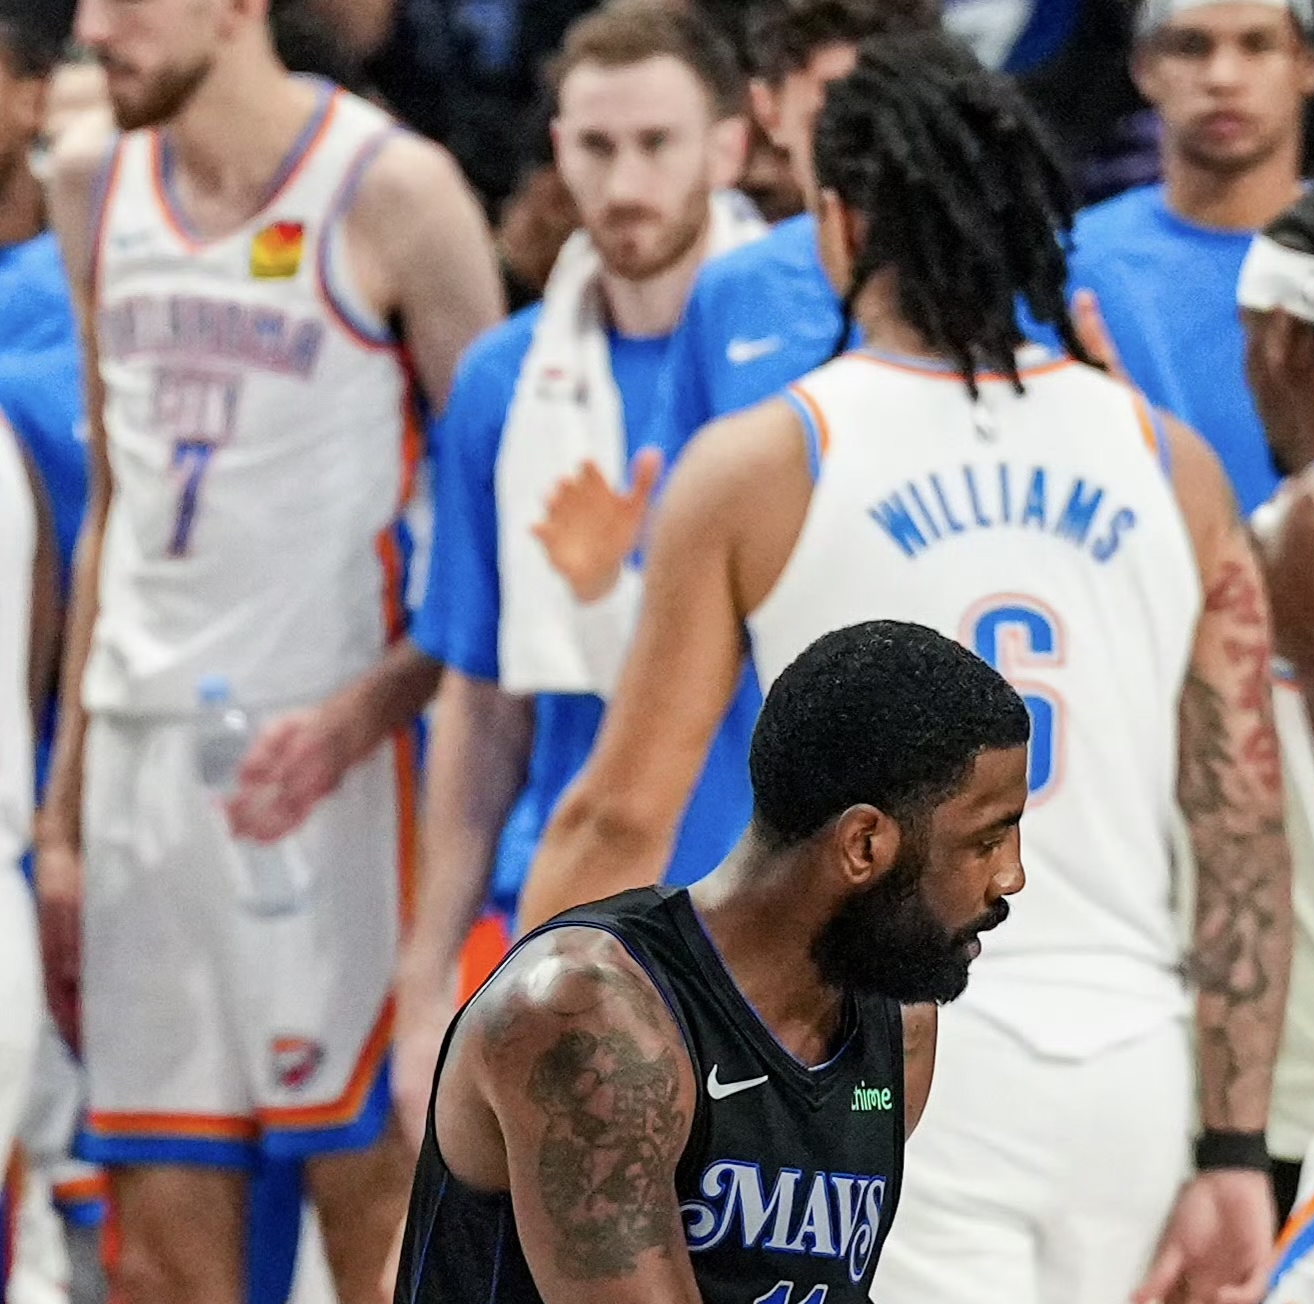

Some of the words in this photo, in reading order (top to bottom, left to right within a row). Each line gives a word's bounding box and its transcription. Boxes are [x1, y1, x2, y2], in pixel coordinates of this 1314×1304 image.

[168, 436, 218, 559] 7
[866, 463, 1136, 563] WILLIAMS
[960, 592, 1067, 810] 6
[852, 1081, 892, 1110] hime
[680, 1159, 886, 1284] MAVS
